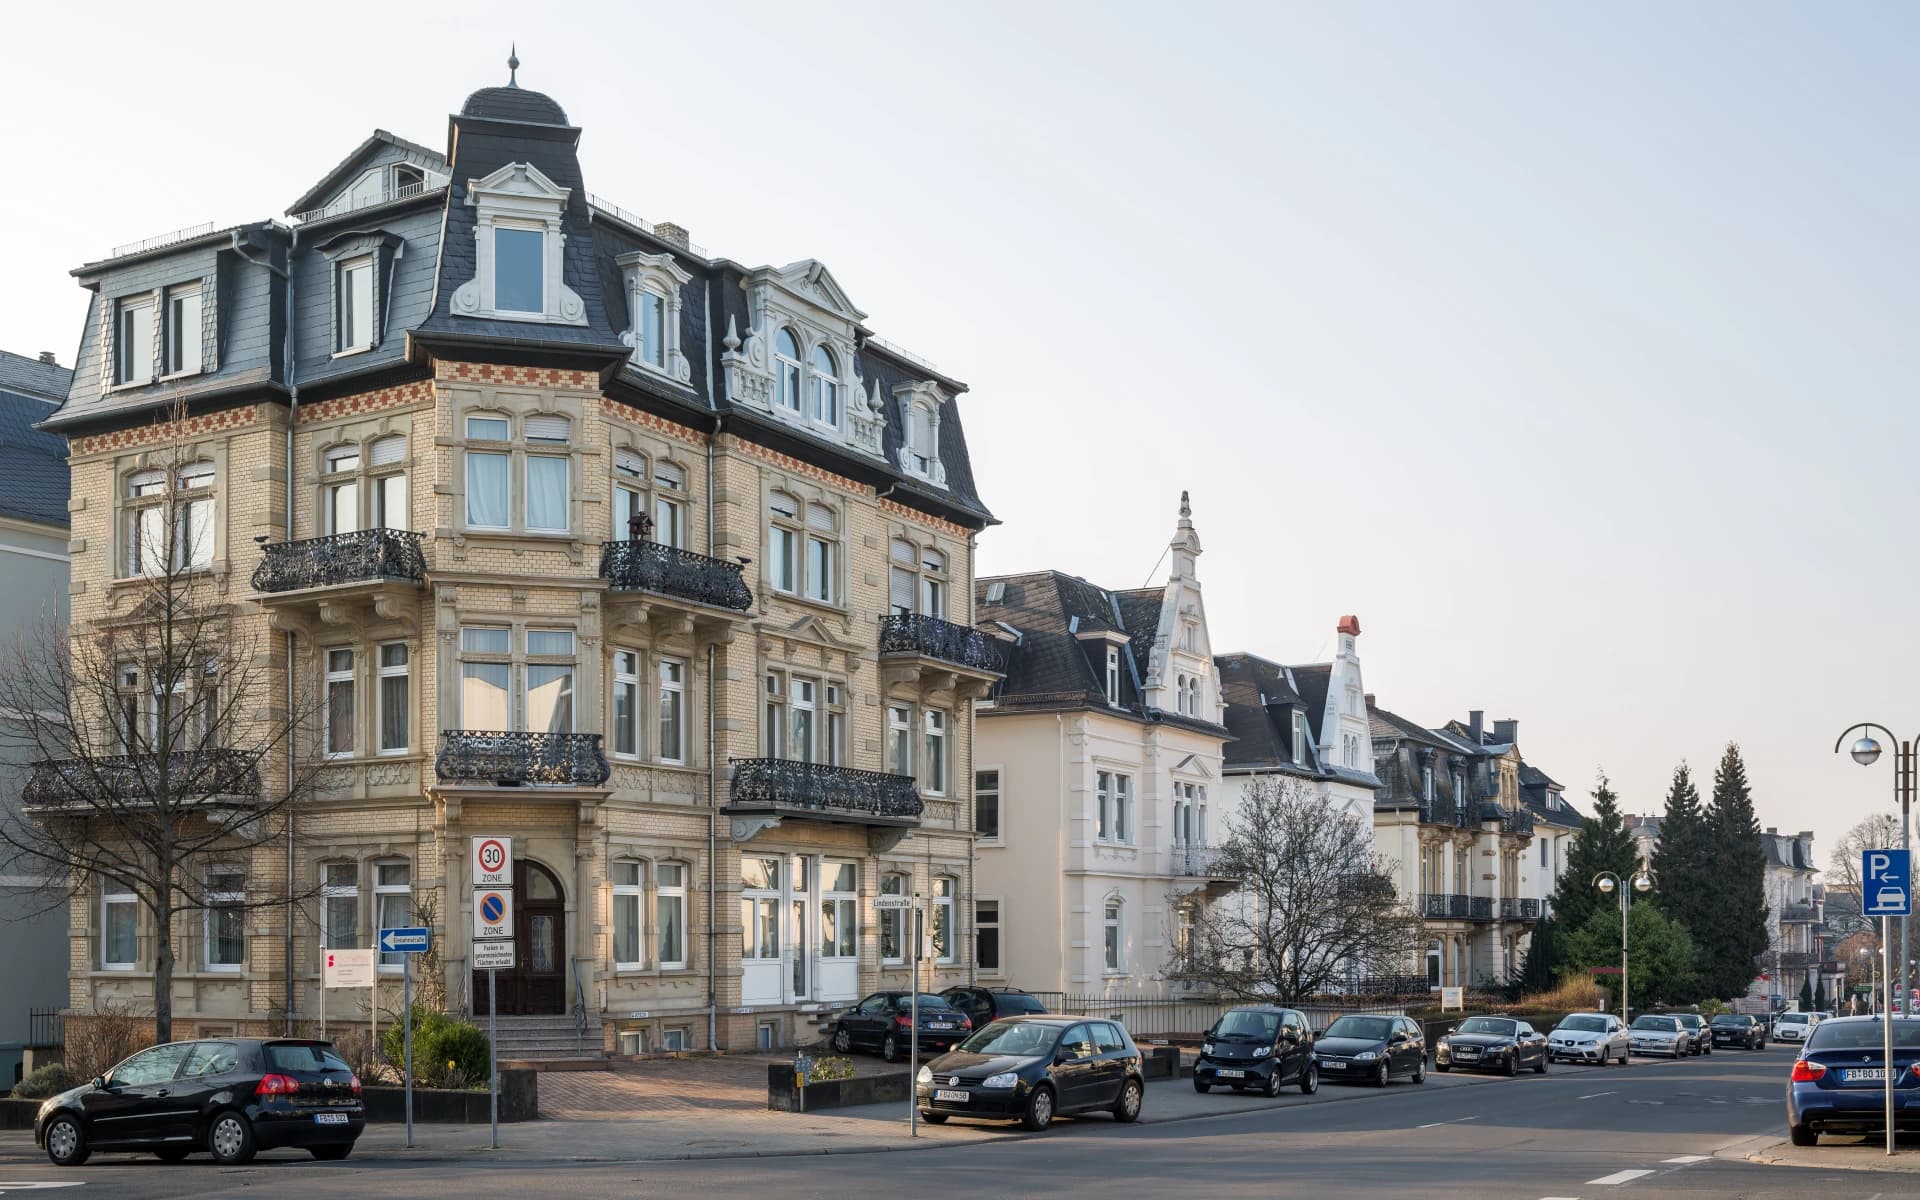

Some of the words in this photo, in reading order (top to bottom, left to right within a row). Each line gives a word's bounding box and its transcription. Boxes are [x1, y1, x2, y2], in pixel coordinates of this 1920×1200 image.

[484, 849, 500, 863] 30
[1870, 854, 1890, 880] P
[482, 874, 503, 882] ZONE
[873, 898, 911, 907] Lindenstraße
[483, 926, 504, 935] ZONE
